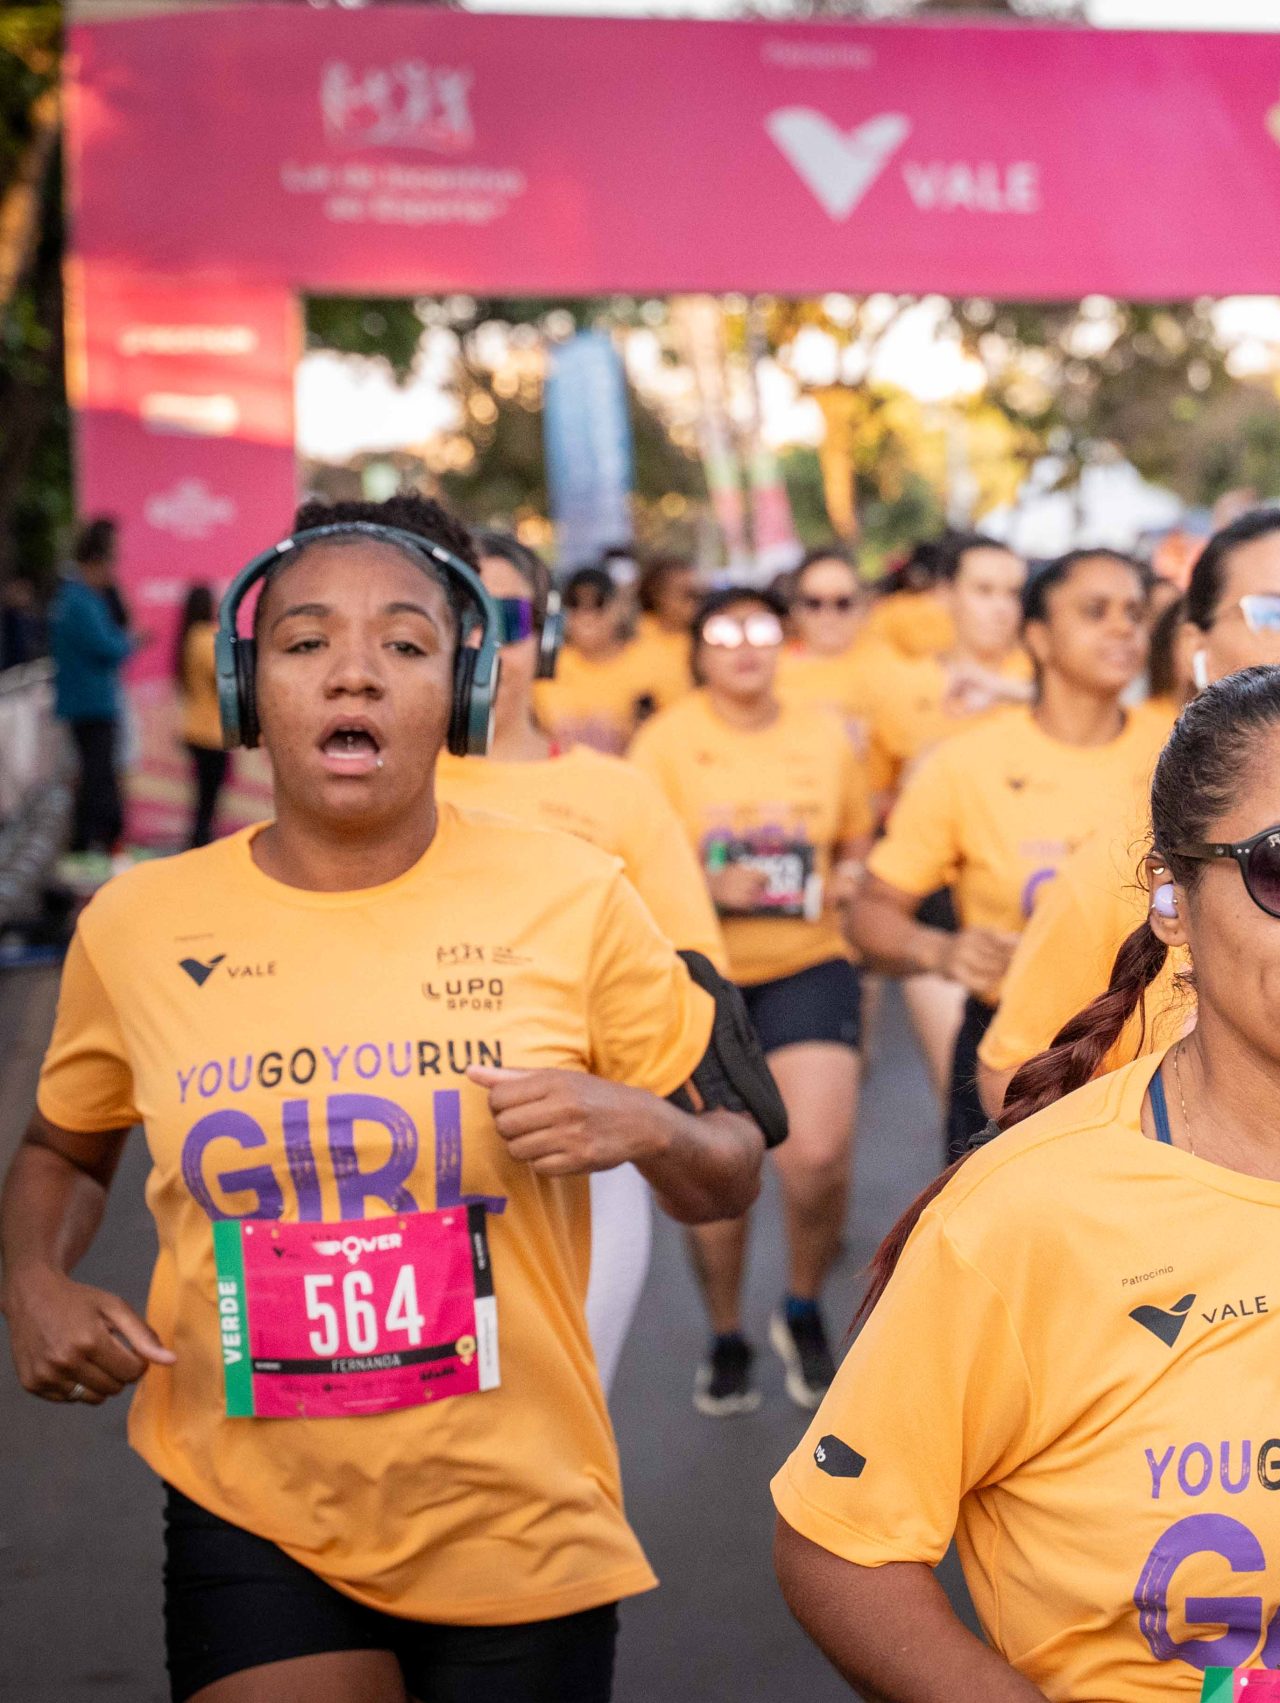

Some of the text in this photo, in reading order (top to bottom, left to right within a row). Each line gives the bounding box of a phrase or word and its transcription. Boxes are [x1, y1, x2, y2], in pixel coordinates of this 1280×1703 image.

[901, 160, 1039, 214] VALE
[227, 960, 277, 979] VALE
[422, 978, 504, 1000] LUPO
[181, 1089, 508, 1223] GIRL
[219, 1280, 243, 1365] VERDE
[304, 1264, 425, 1356] 564
[1201, 1295, 1269, 1324] VALE
[331, 1353, 402, 1373] FERNANDA
